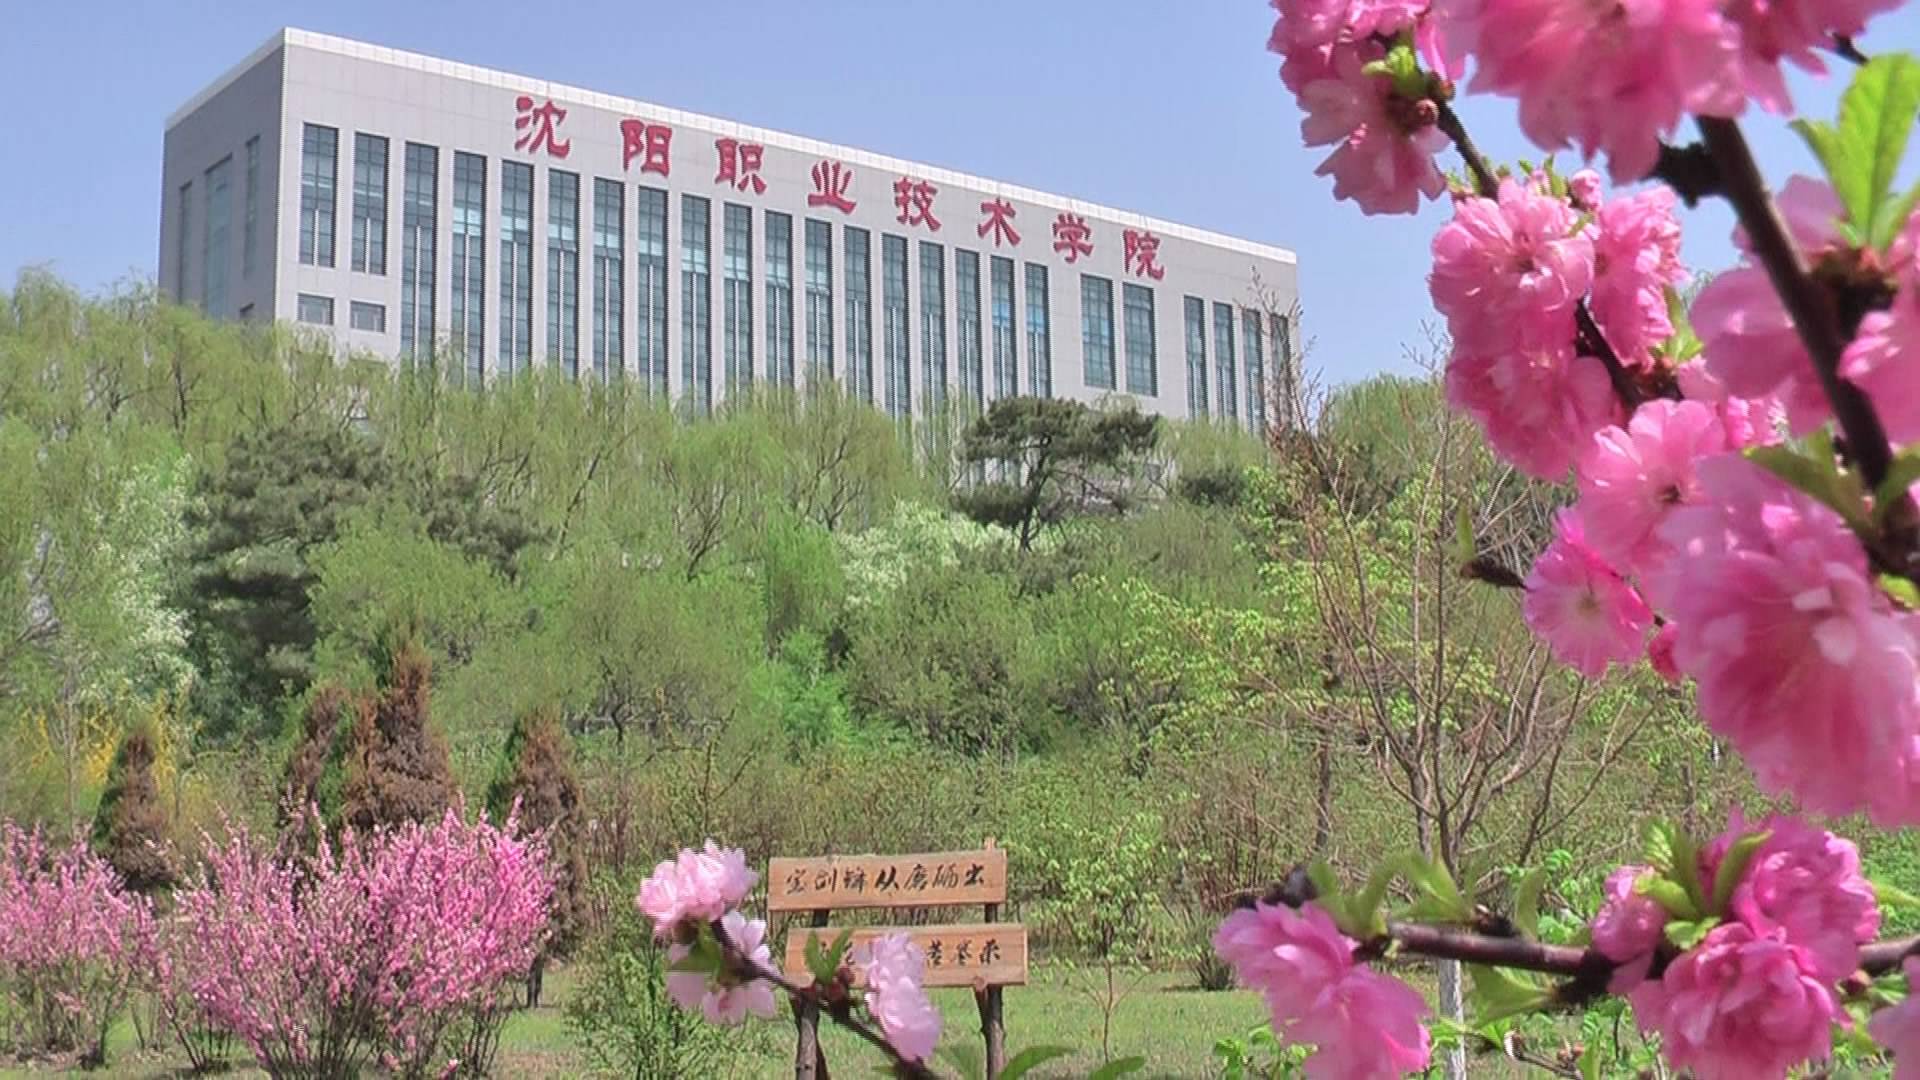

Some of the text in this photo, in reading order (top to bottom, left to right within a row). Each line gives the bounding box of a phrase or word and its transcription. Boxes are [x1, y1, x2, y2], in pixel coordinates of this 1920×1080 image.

[514, 95, 1165, 280] 沈阳职业技术学院
